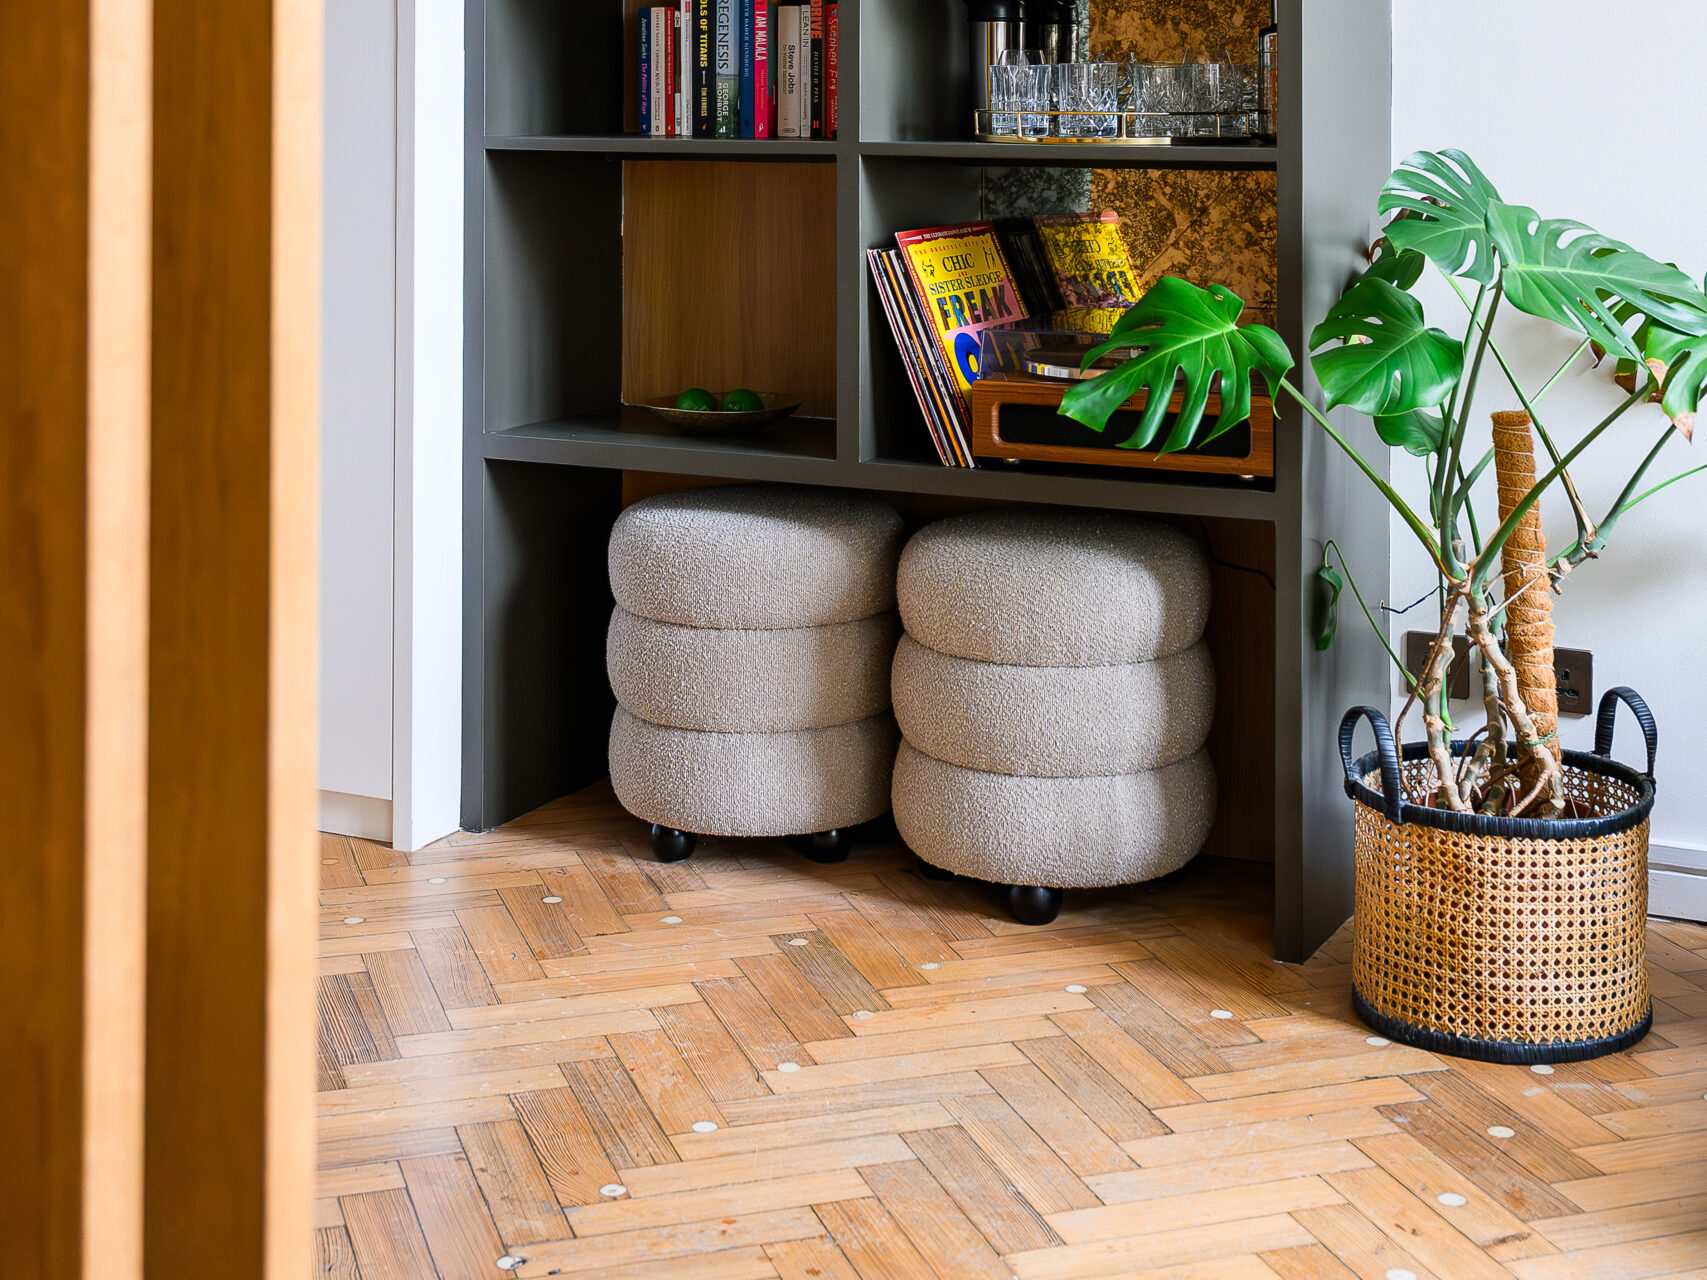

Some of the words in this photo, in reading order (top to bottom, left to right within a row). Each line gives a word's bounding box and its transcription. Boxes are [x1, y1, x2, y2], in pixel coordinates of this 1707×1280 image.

[699, 18, 708, 32] OF
[755, 15, 767, 29] AM
[699, 33, 708, 68] TITANS
[755, 30, 767, 61] MALALA
[802, 38, 809, 48] IN
[828, 17, 838, 65] Stephen
[788, 44, 796, 70] Steve
[787, 71, 796, 95] Jobs
[828, 69, 838, 90] Fry
[942, 252, 975, 273] CHIC
[928, 280, 963, 296] SISTER
[964, 271, 1001, 289] SLEDGE
[936, 284, 1014, 331] FREAK
